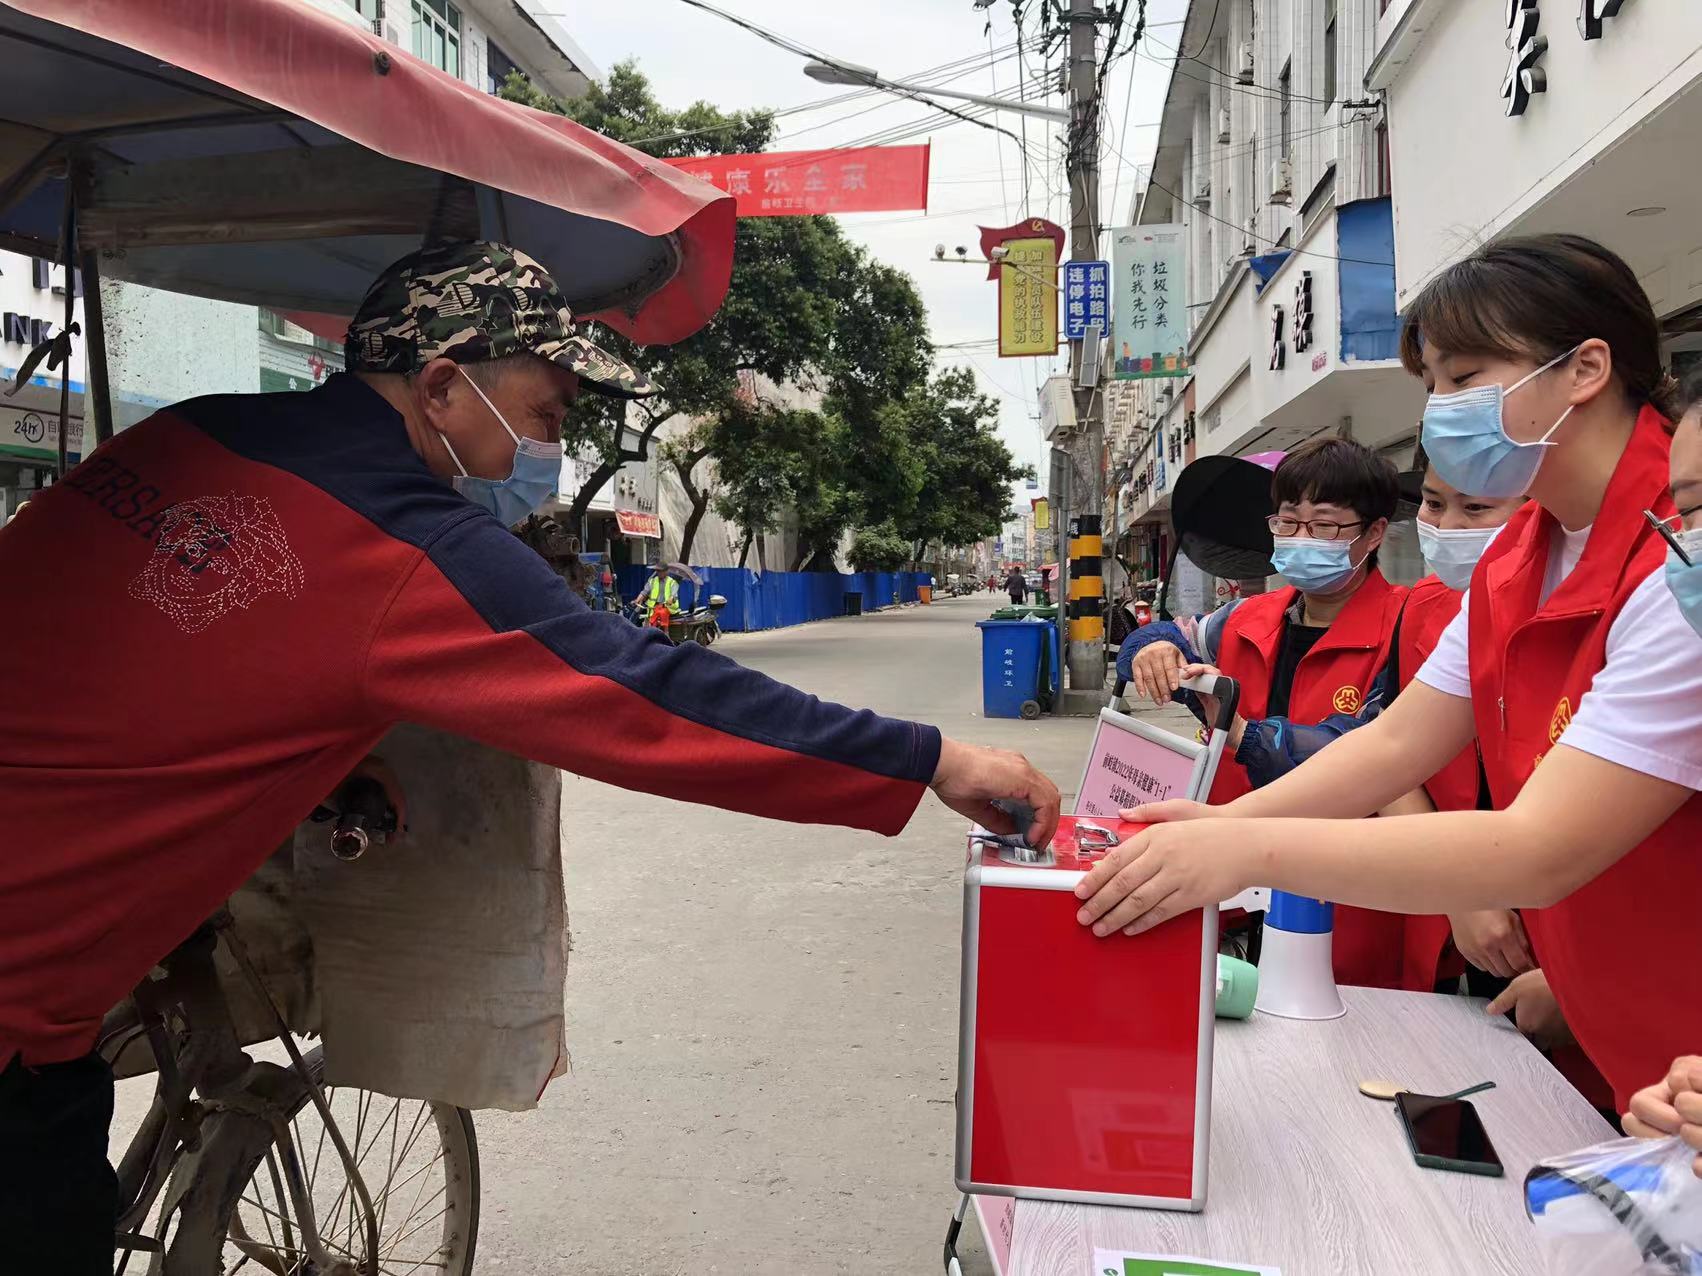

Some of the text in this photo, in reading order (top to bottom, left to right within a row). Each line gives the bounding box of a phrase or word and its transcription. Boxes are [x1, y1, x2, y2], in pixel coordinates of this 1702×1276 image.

[1069, 267, 1085, 334] 违停电子
[1130, 263, 1147, 330] 你我先行
[1152, 261, 1168, 328] 垃圾分类
